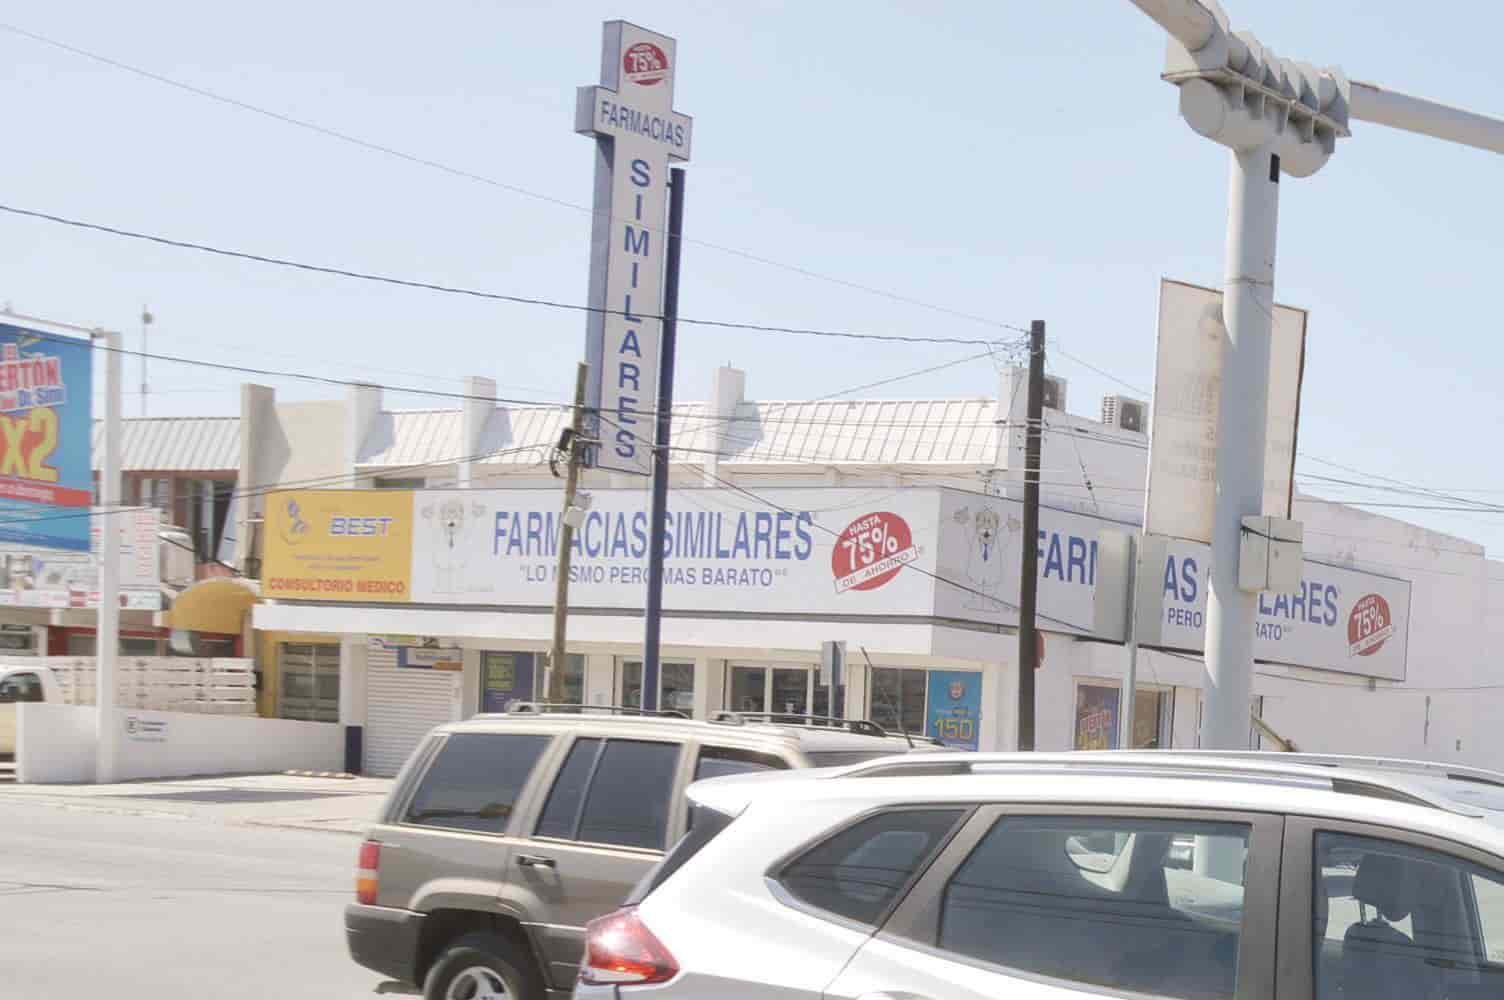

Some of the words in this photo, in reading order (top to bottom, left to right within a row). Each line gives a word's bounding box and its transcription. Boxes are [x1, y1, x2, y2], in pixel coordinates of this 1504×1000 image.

[600, 101, 684, 147] FARMACIAS
[615, 159, 651, 459] SIMILARES
[328, 517, 393, 537] BEST
[848, 514, 881, 537] HASTA
[842, 521, 898, 571] 75%
[270, 577, 353, 592] CONSULTORIO
[1352, 602, 1385, 638] 75%
